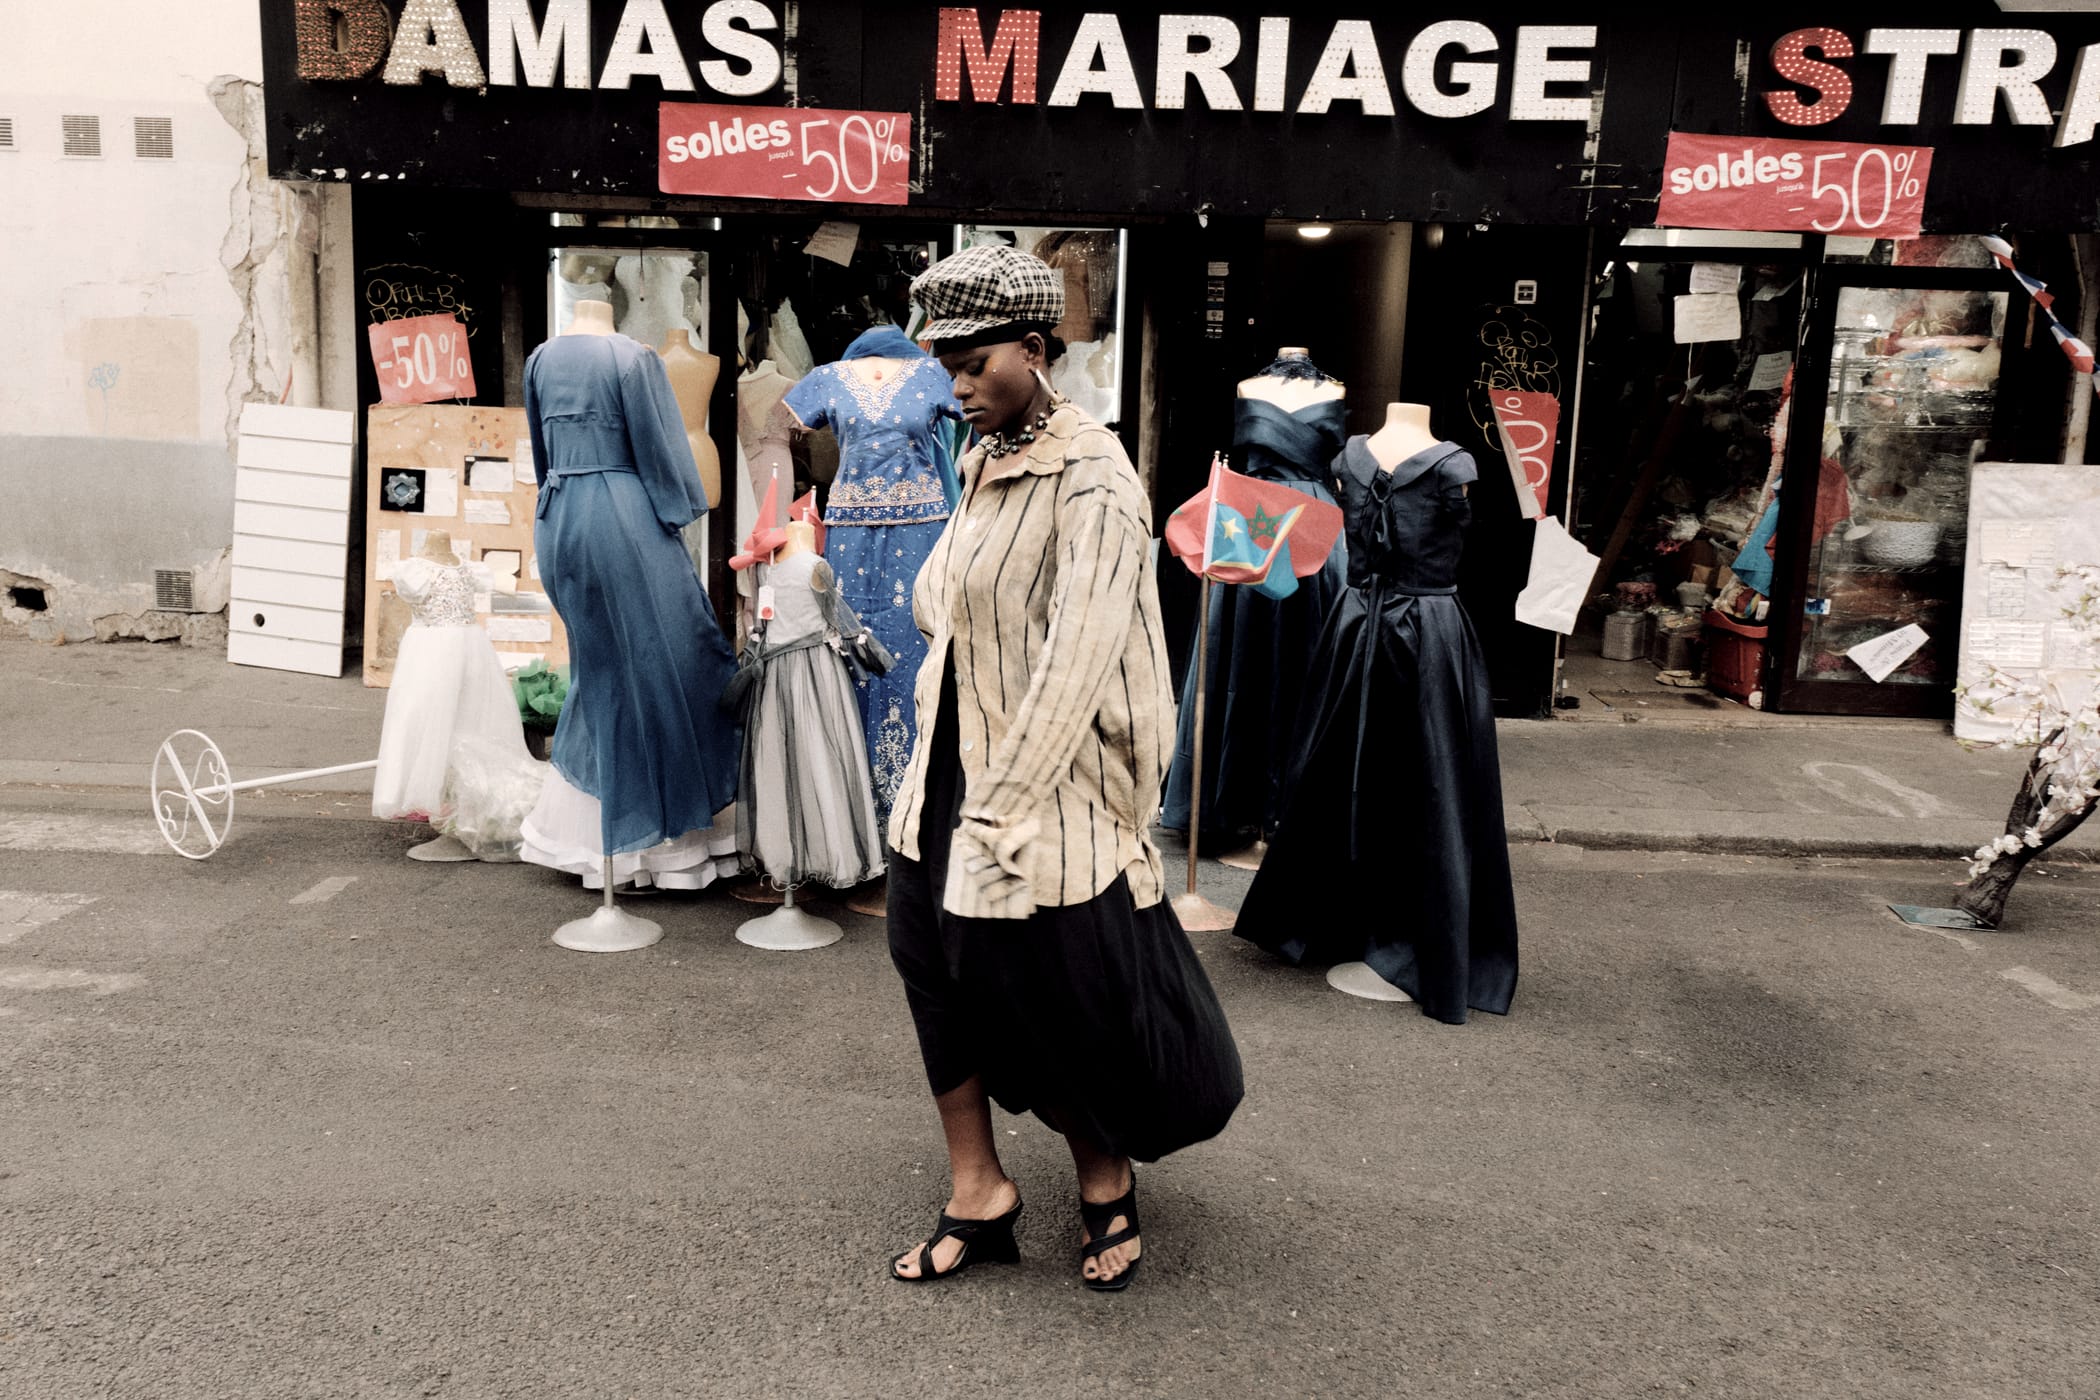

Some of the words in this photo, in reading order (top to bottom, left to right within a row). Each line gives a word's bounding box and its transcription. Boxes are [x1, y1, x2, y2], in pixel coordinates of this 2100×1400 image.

[296, 0, 782, 97] DAMAS
[935, 8, 1598, 121] MARIAGE
[666, 117, 791, 163] soldes
[1670, 149, 1804, 195] soldes
[379, 332, 468, 389] -50%
